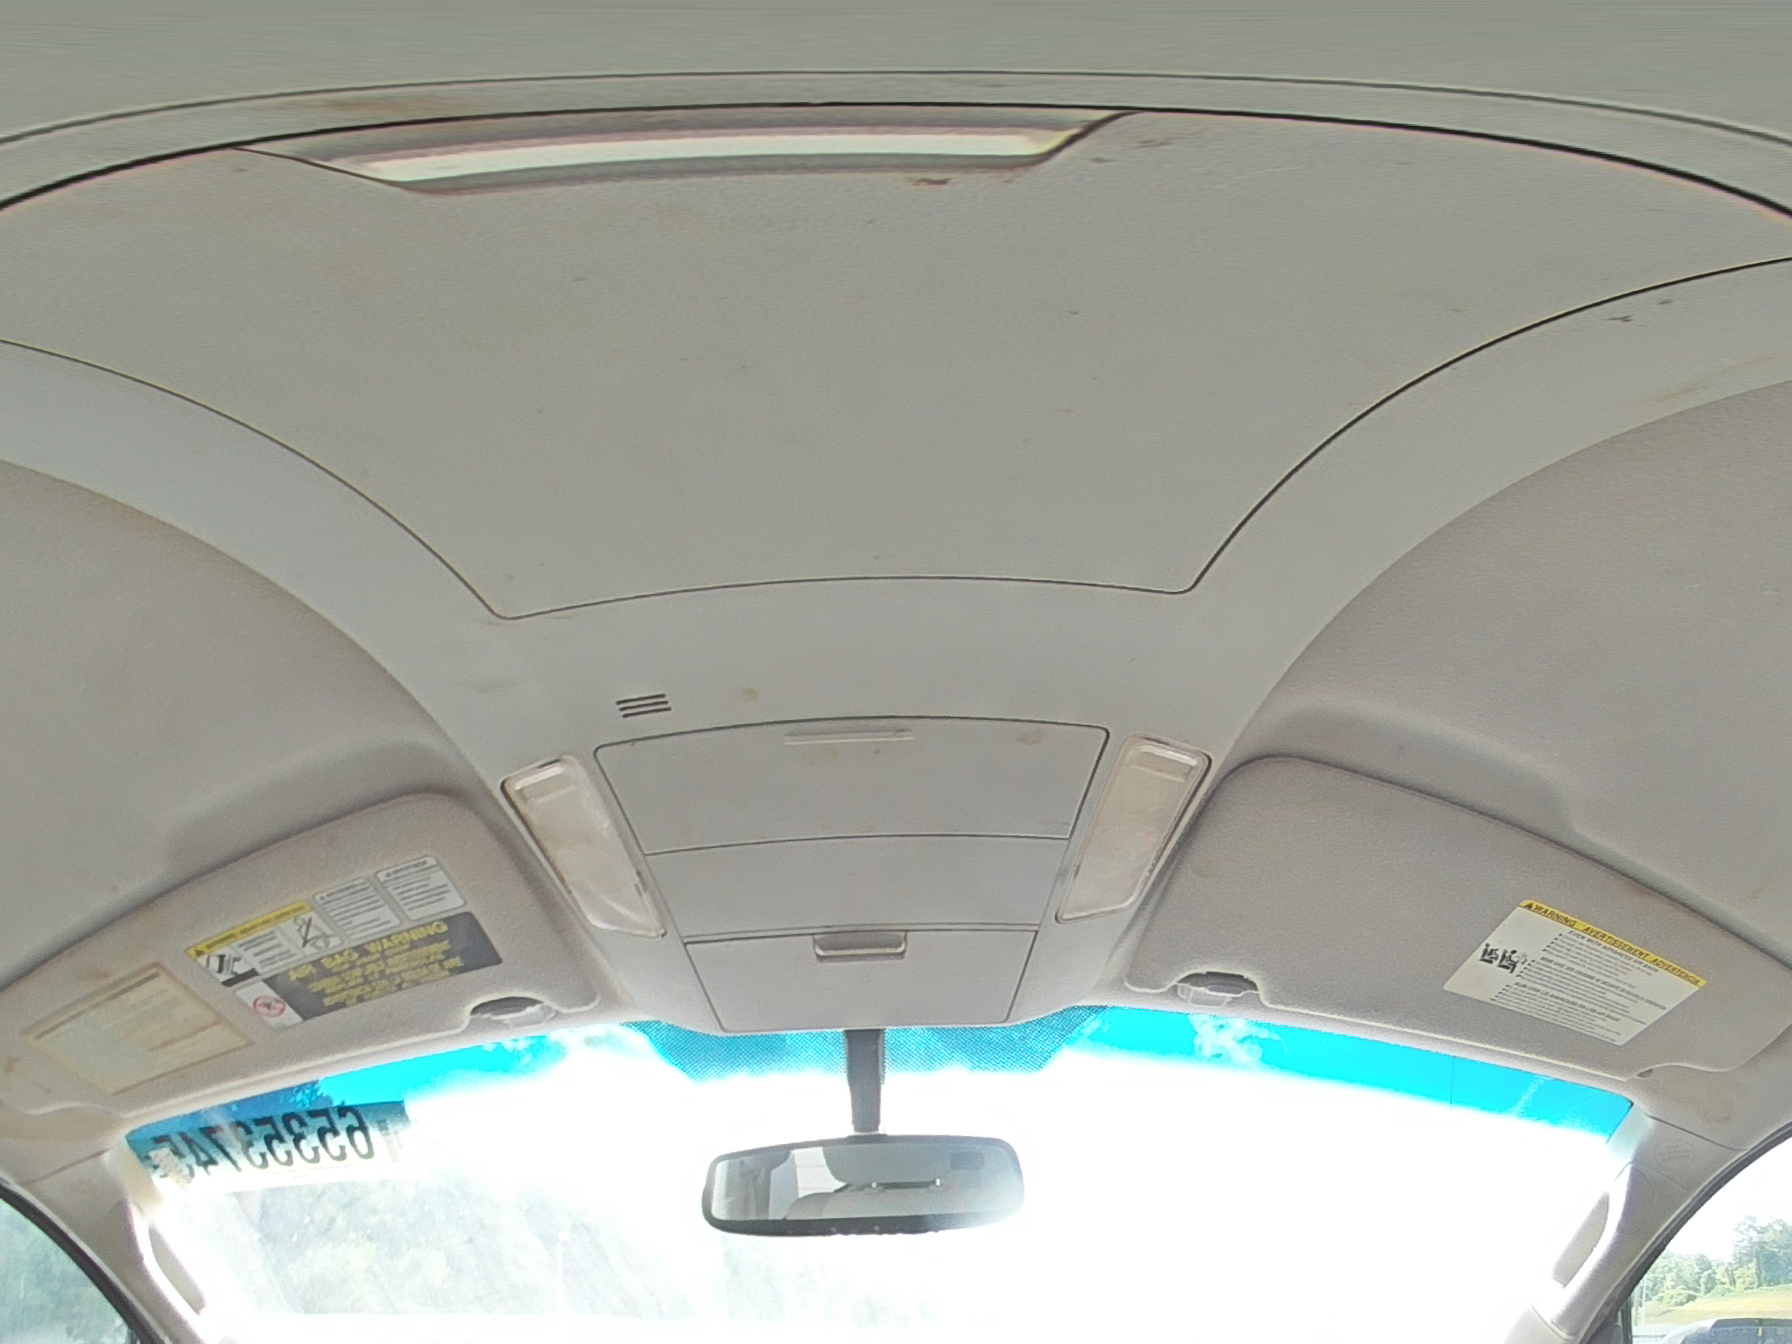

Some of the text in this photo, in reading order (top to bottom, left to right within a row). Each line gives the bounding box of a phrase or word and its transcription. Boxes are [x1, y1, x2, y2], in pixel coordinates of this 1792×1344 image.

[1535, 904, 1577, 928] WARNING
[288, 921, 449, 982] AIR BAG WARNING
